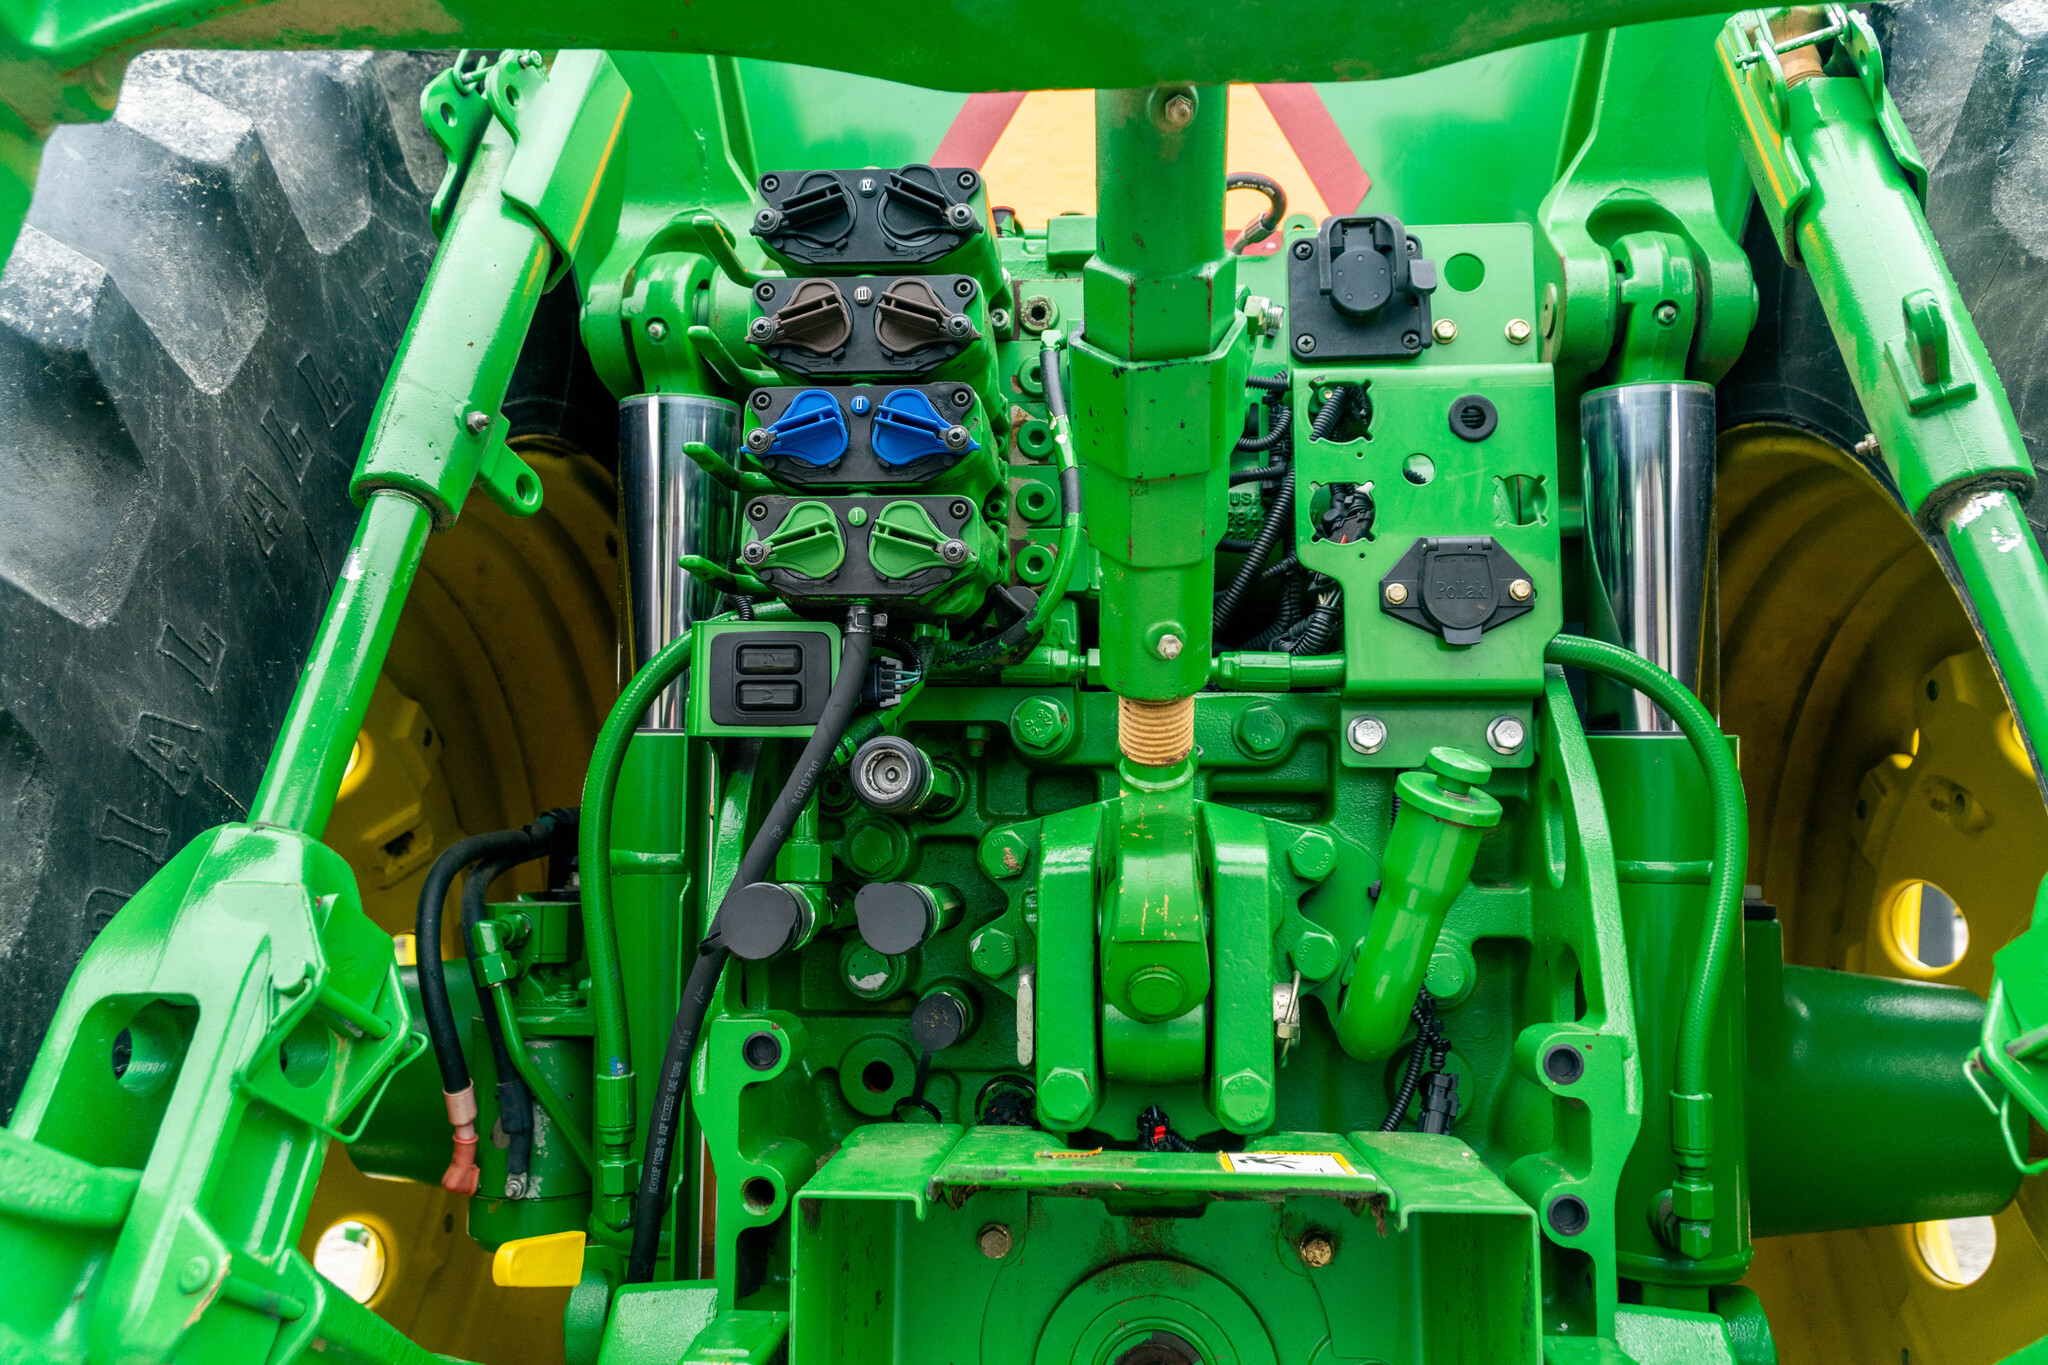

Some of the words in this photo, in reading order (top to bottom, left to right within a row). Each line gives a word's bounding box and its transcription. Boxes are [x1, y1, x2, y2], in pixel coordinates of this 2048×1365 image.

[862, 179, 872, 191] IV
[857, 288, 868, 300] III
[855, 397, 863, 410] II
[225, 353, 355, 560] ALL
[854, 509, 860, 522] I
[1435, 580, 1488, 600] Pollak
[667, 1079, 679, 1093] SAE
